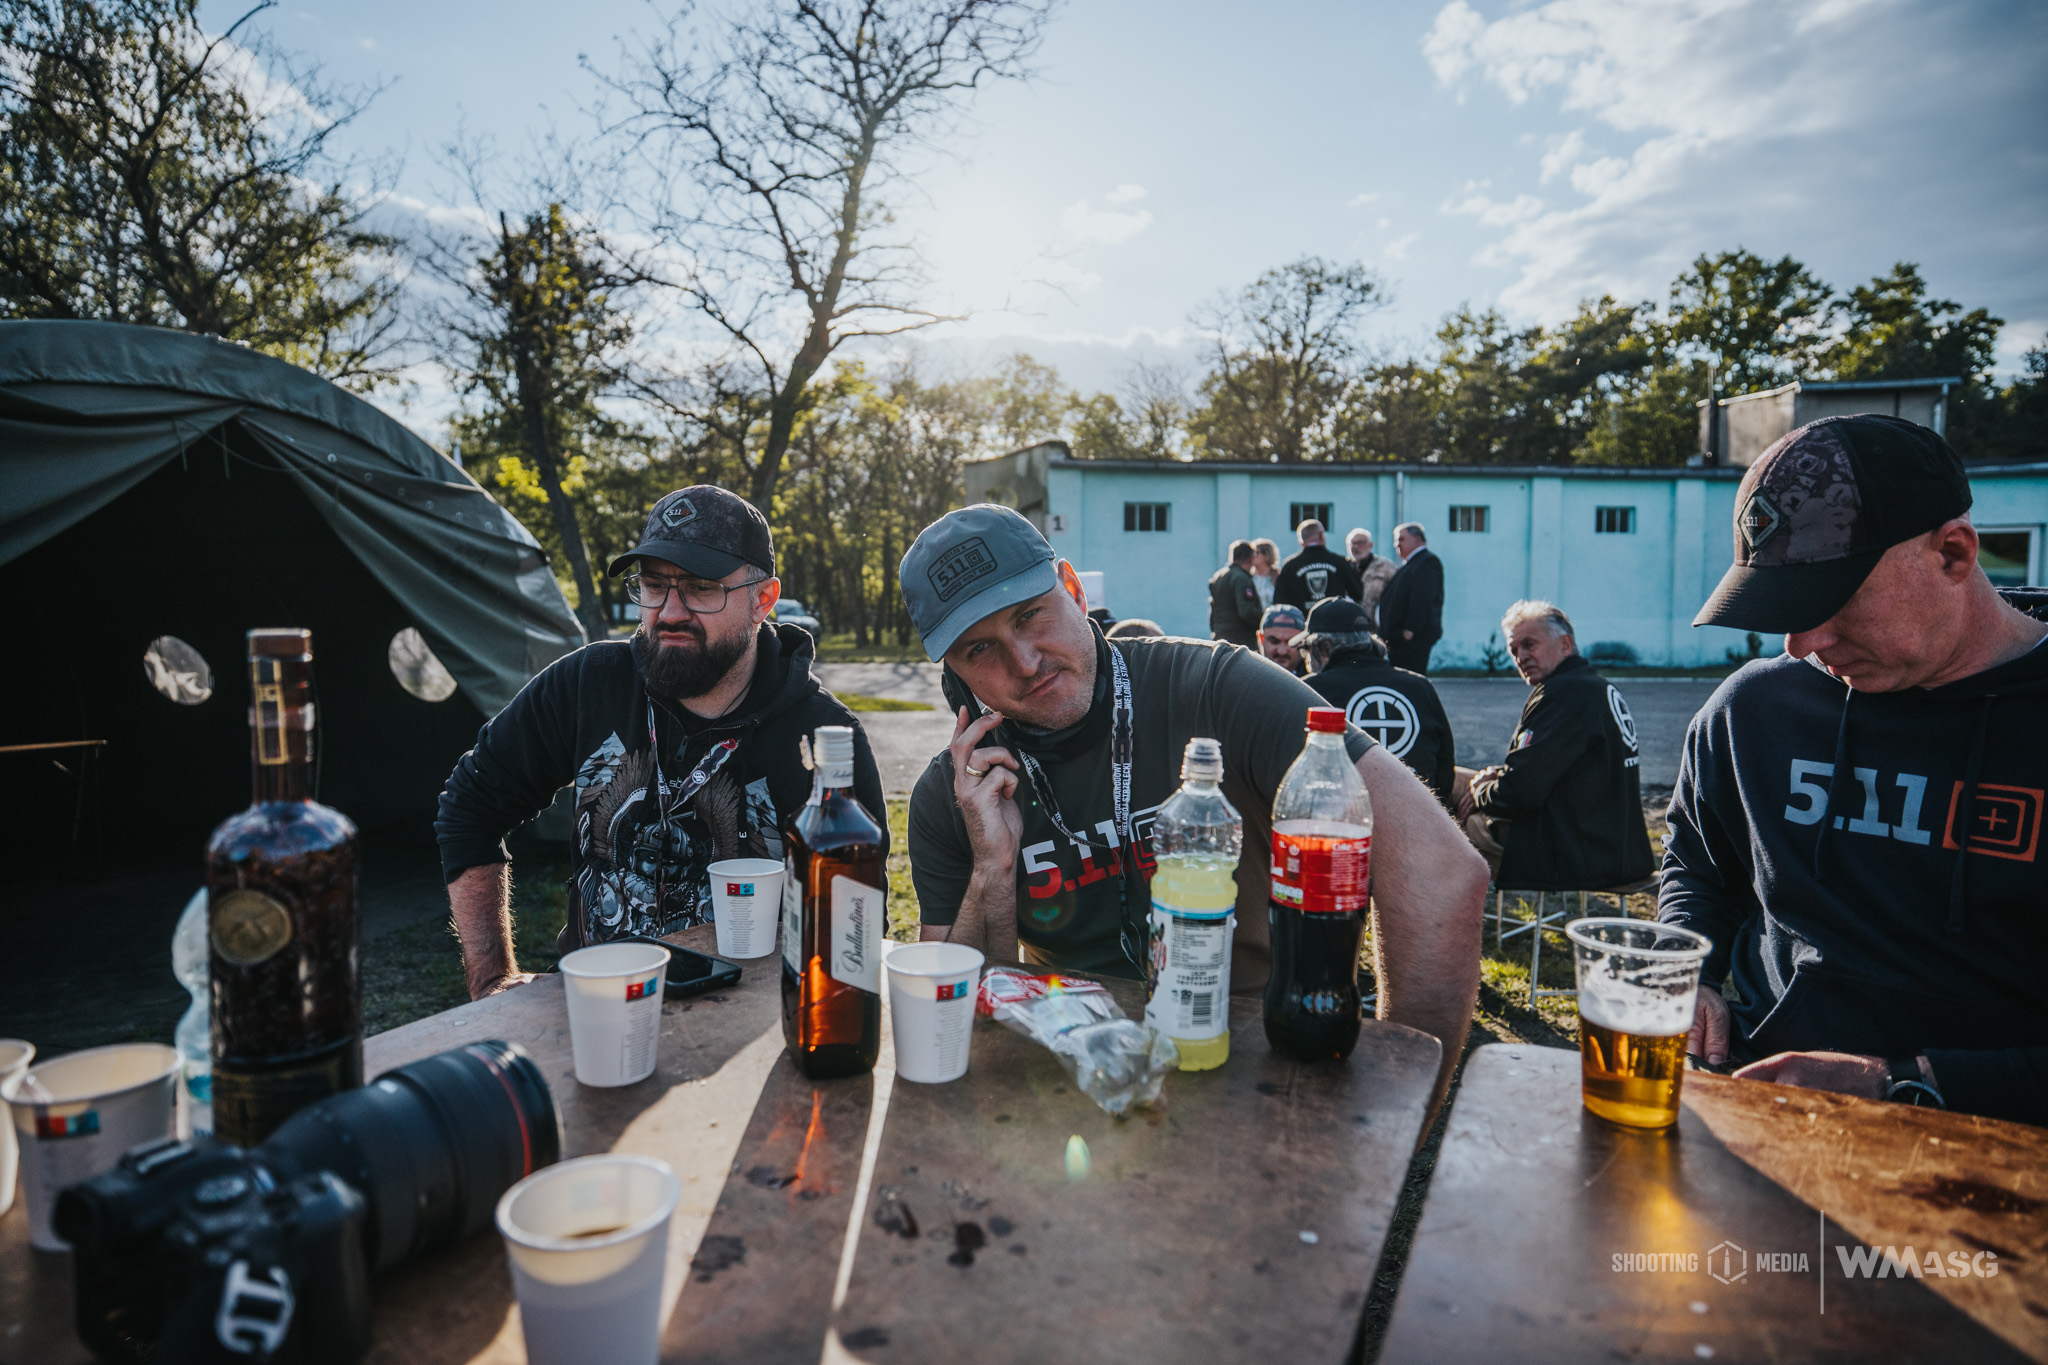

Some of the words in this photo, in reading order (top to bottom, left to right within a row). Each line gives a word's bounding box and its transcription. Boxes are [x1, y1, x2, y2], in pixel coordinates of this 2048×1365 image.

[1053, 515, 1063, 531] 1
[937, 557, 969, 588] 5.11
[1114, 698, 1123, 710] XIX
[1122, 762, 1131, 802] STRZELECKI
[1784, 758, 1931, 846] 5.11
[1022, 819, 1130, 899] 5.11
